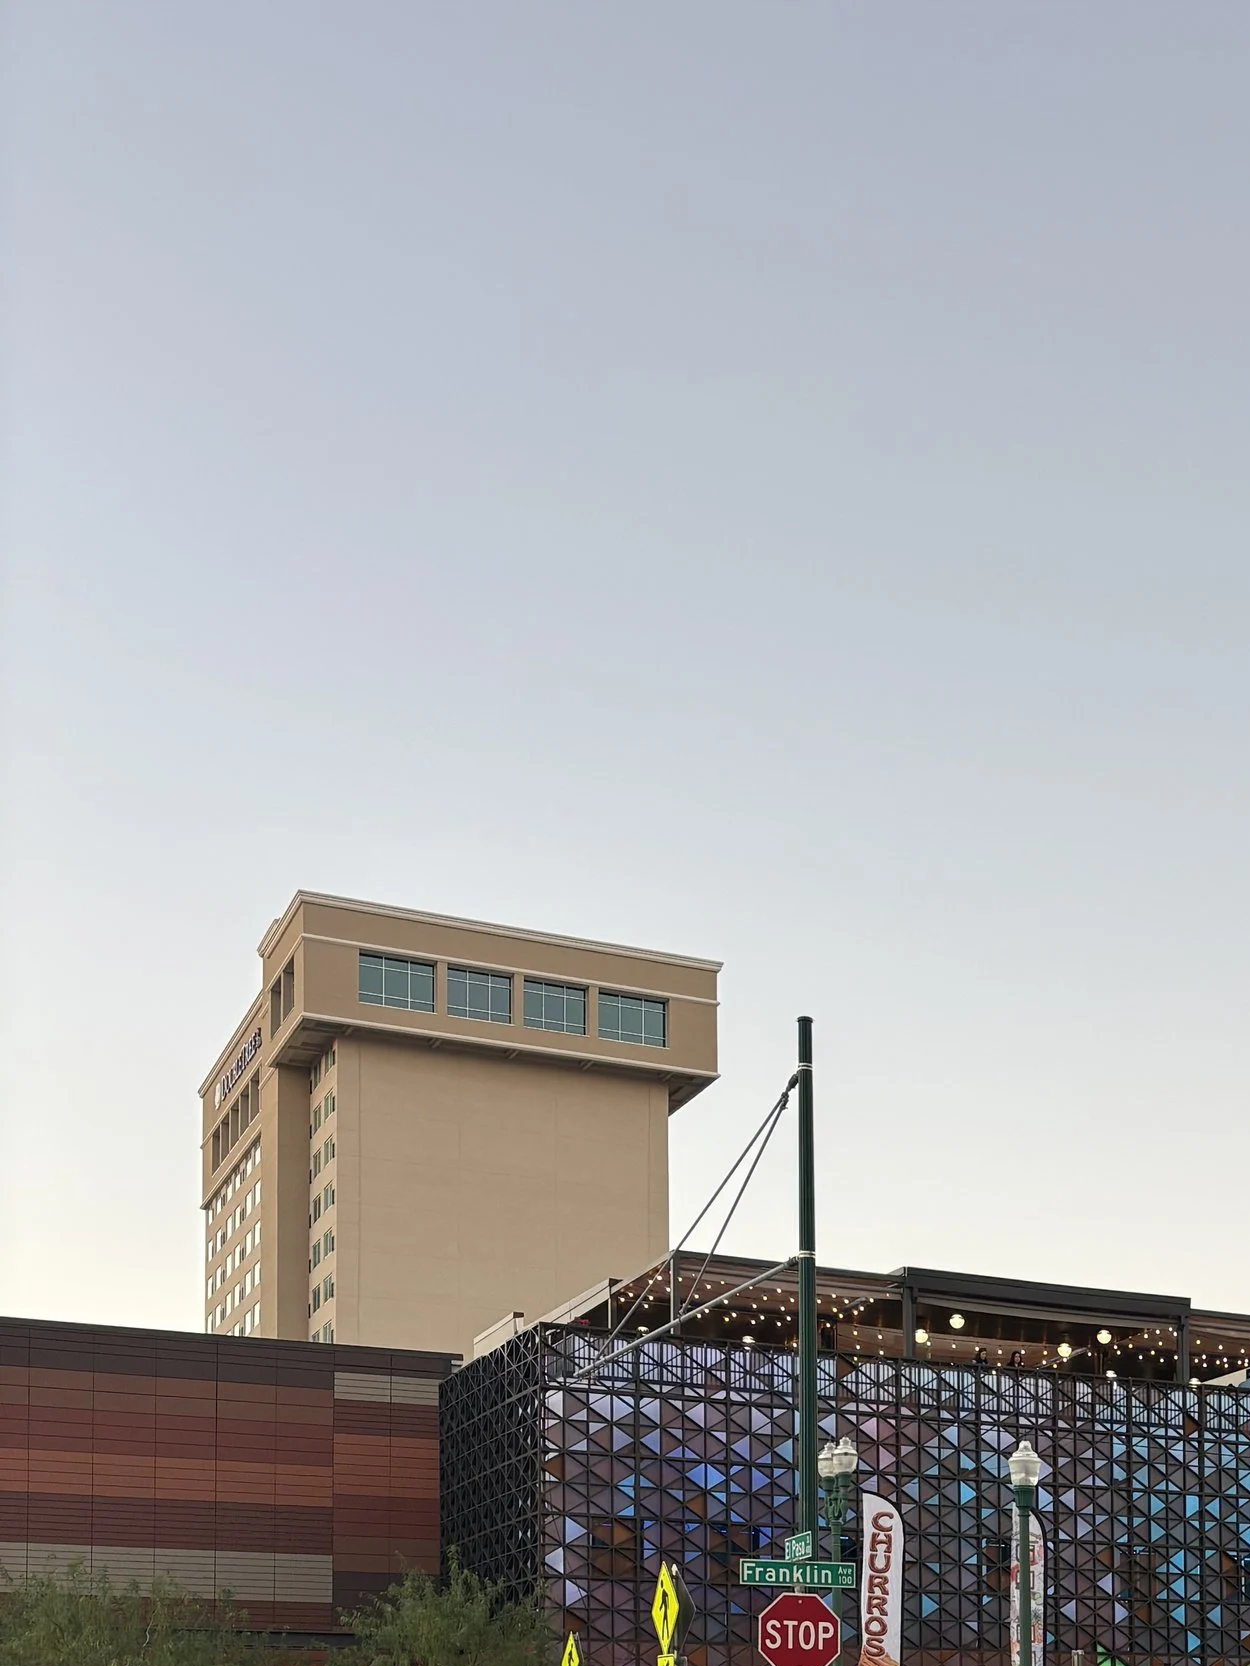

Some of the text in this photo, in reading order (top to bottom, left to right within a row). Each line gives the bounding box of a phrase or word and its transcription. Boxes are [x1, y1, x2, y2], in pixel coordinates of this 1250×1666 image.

[743, 1562, 832, 1584] Franklin
[838, 1566, 852, 1575] Ave
[838, 1575, 853, 1585] 100
[863, 1511, 894, 1658] CHURROS
[765, 1619, 834, 1650] STOP
